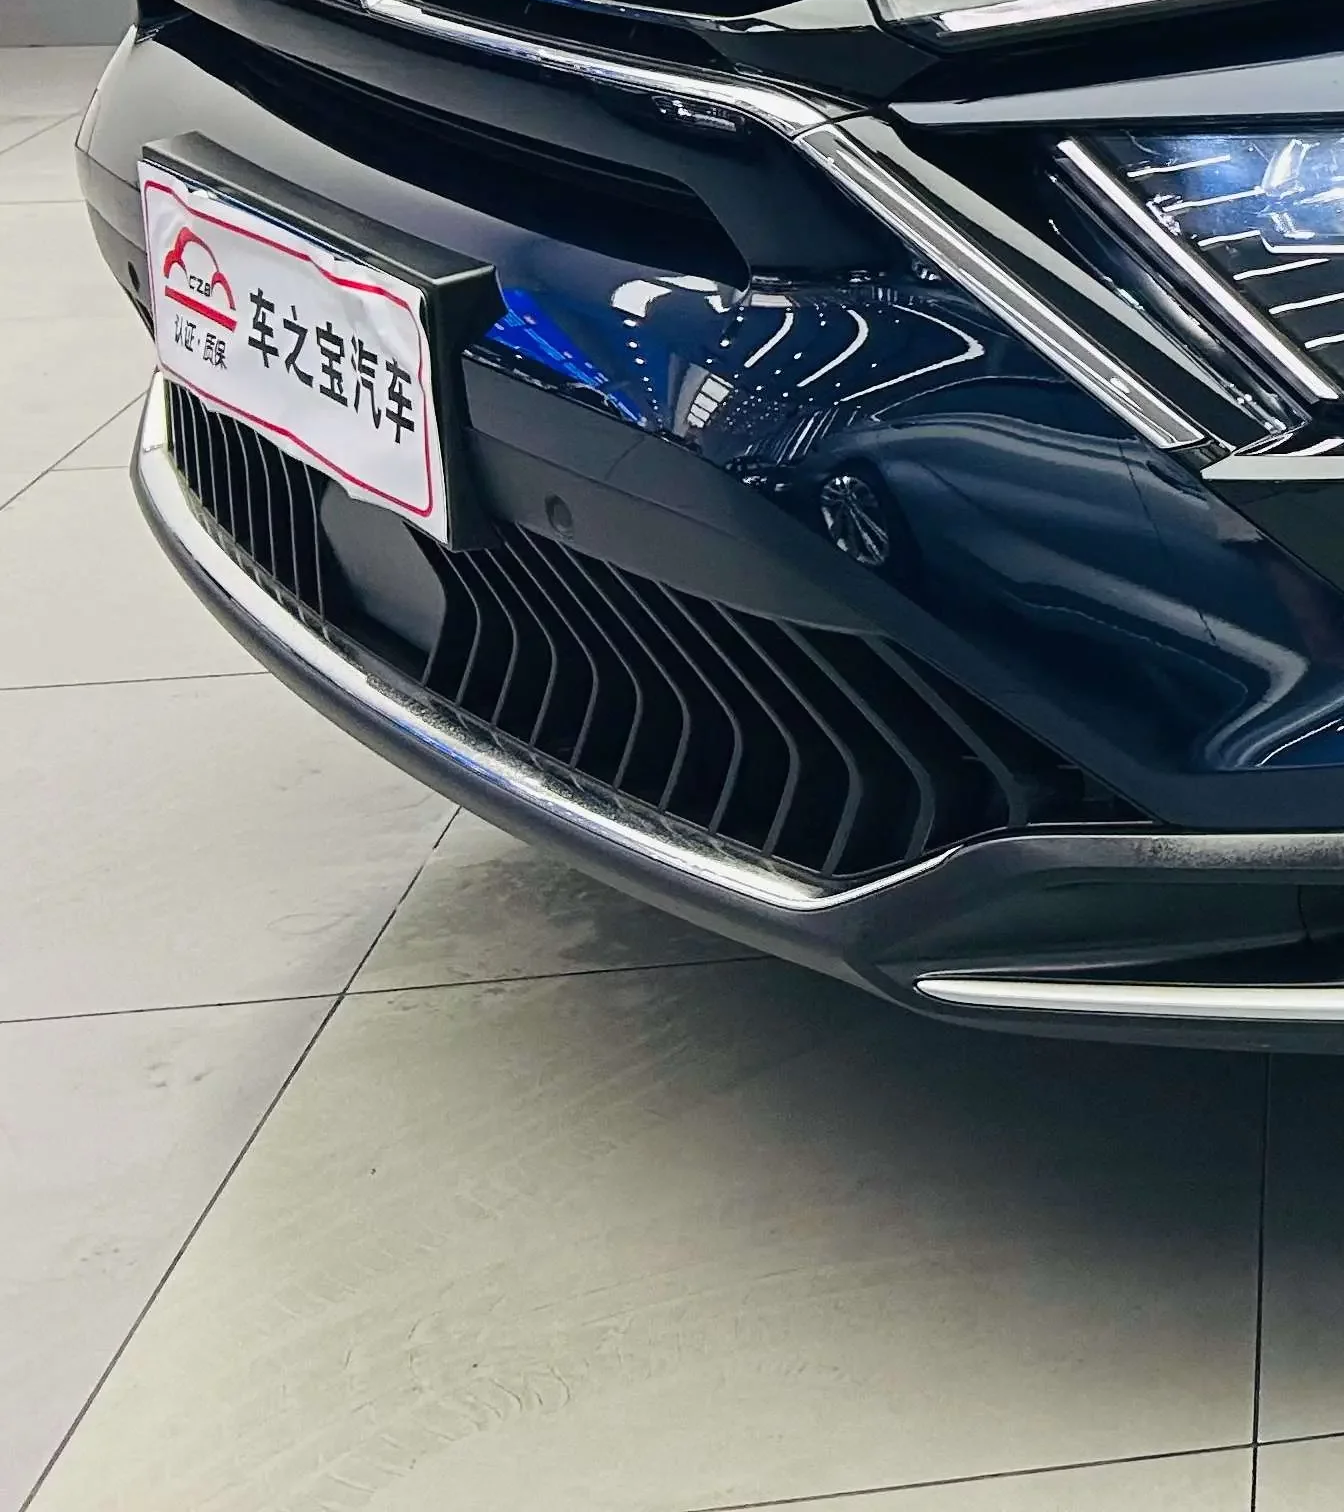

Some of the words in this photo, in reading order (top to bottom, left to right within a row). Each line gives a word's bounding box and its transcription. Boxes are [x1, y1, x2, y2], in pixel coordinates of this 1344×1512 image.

[188, 274, 213, 300] CZB
[247, 287, 415, 445] 车之宝汽车
